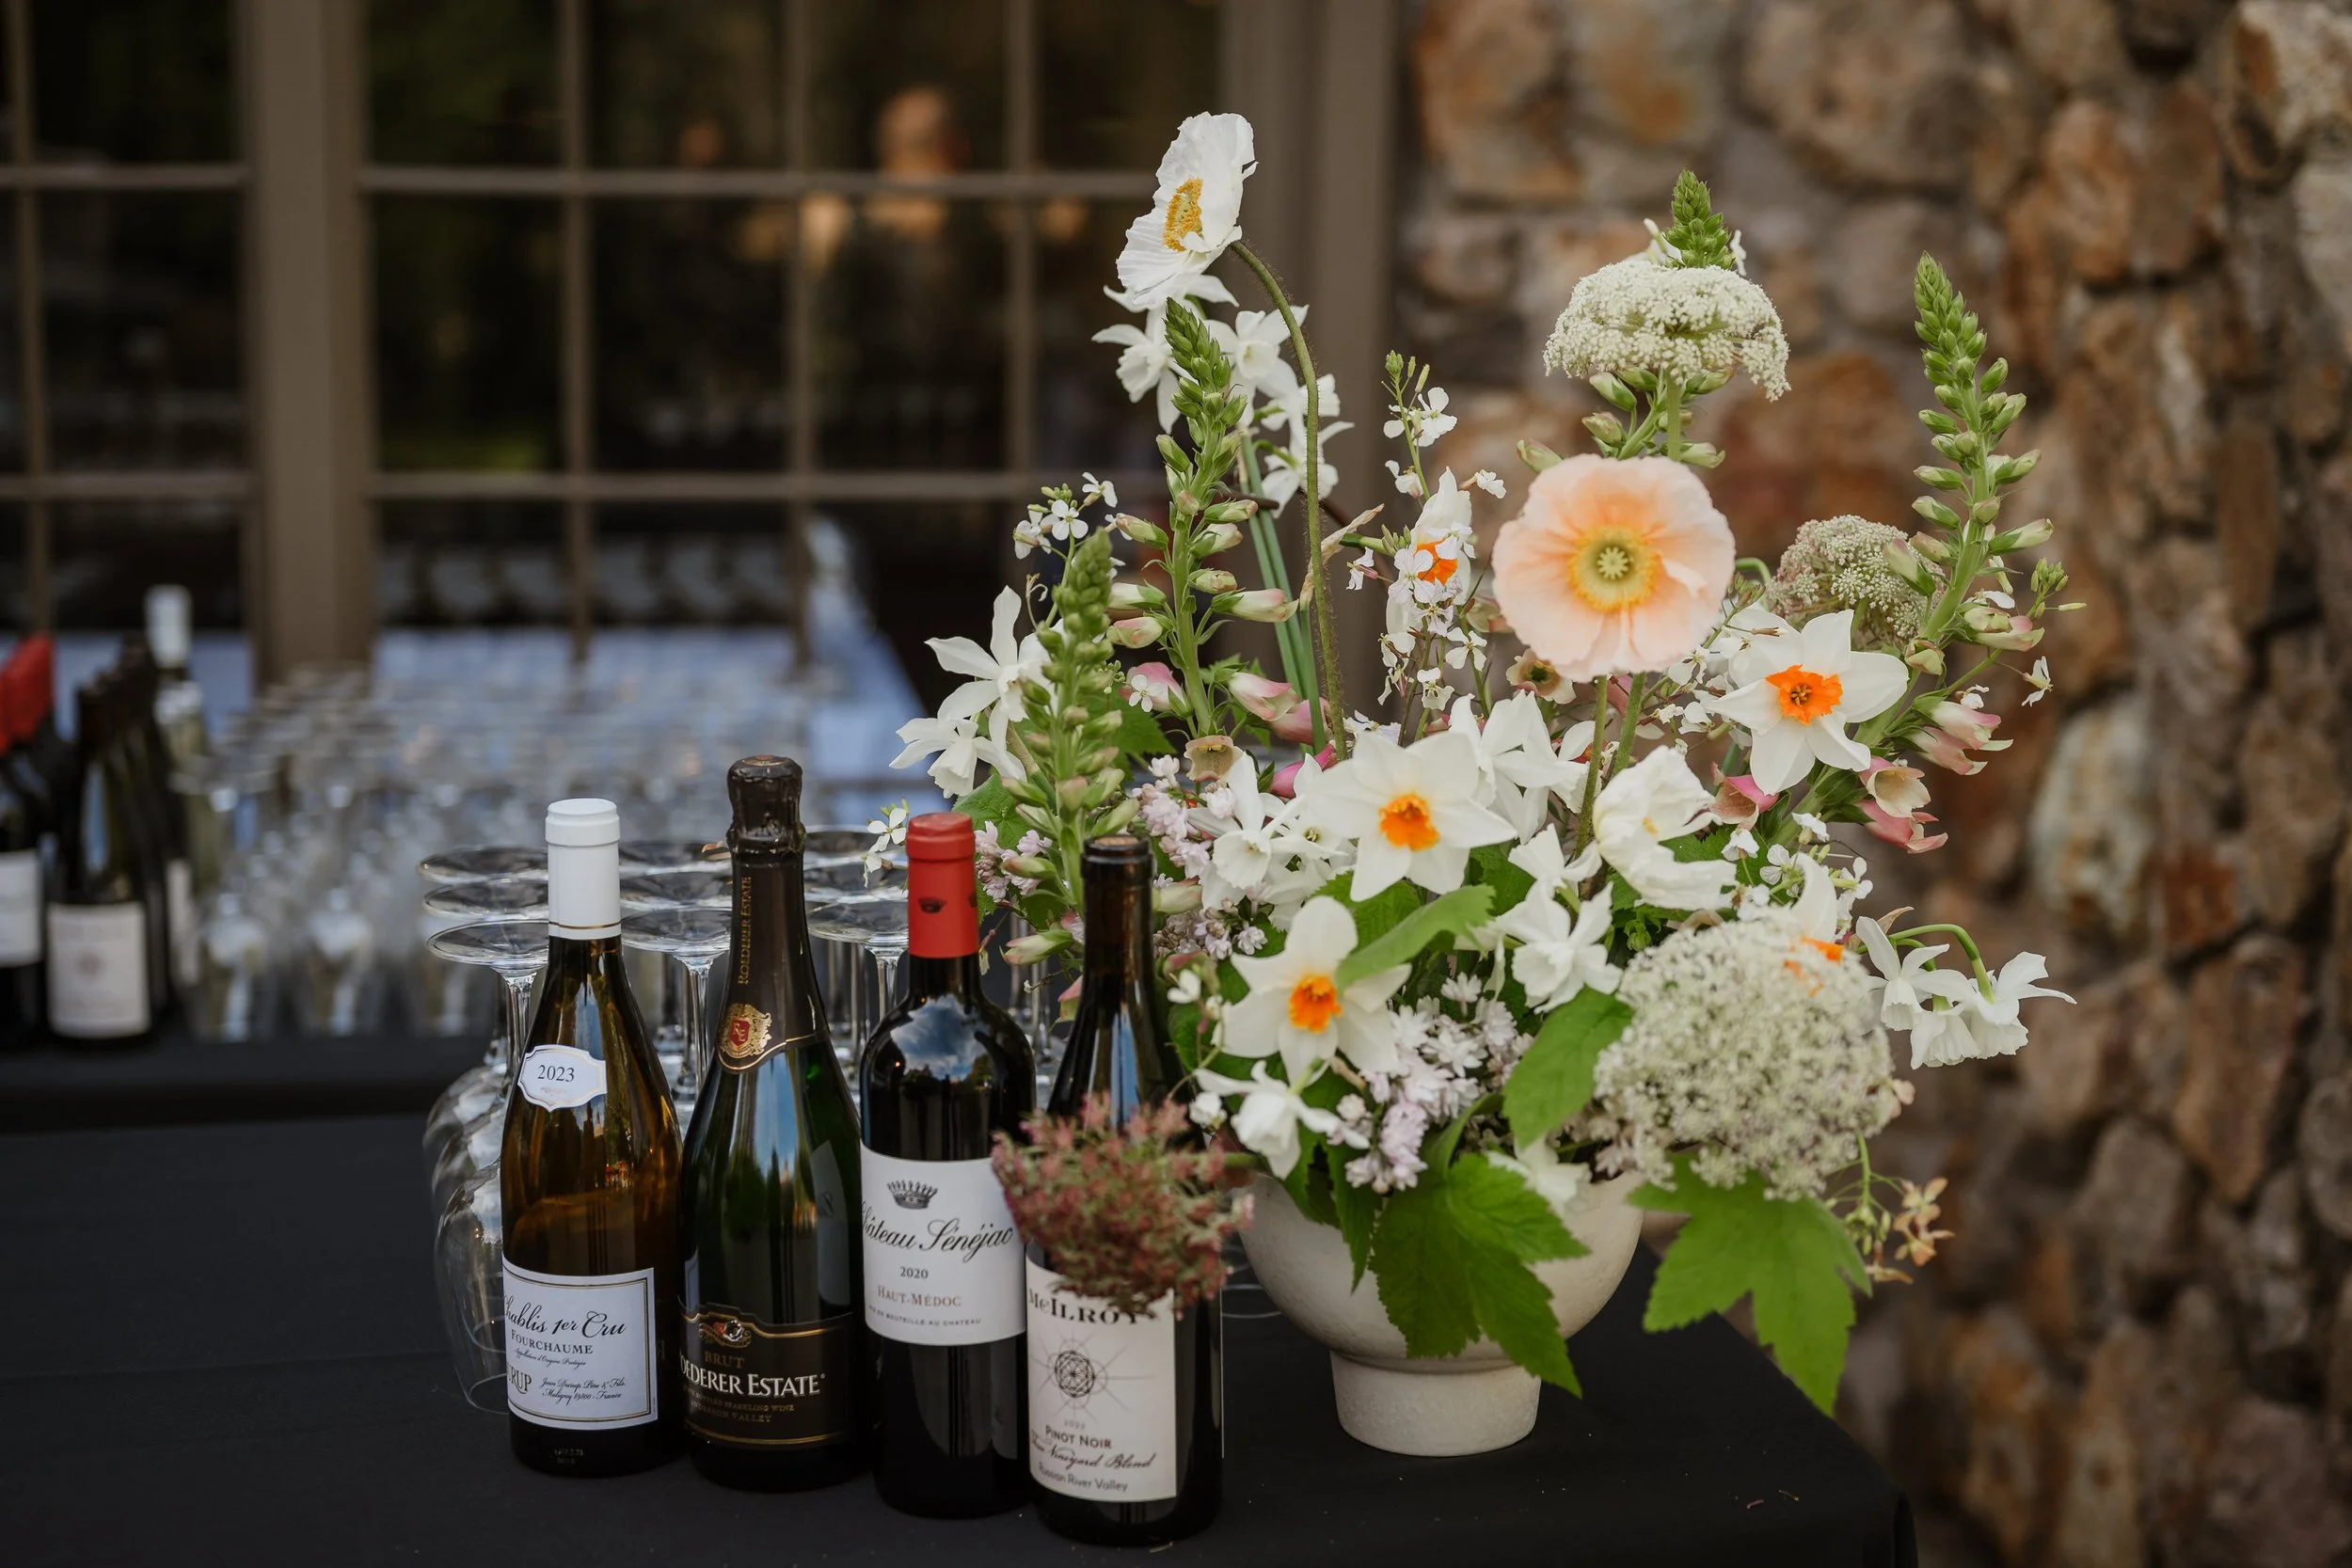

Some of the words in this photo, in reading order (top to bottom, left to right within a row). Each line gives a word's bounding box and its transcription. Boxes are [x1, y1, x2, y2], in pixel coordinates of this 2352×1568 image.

[740, 876, 752, 917] ESTATE
[738, 919, 751, 985] ROEDERER
[537, 1065, 575, 1083] 2023
[918, 1217, 1014, 1264] Sénéjac
[900, 1266, 929, 1280] 2020
[877, 1285, 961, 1307] HAUT-MÉDOC
[505, 1294, 548, 1333] hablis
[550, 1319, 579, 1335] 1er
[581, 1310, 628, 1338] Cru
[885, 1312, 925, 1326] BOUTEILLE
[511, 1329, 594, 1354] FOURCHAUME
[704, 1350, 745, 1370] BRUT
[679, 1346, 745, 1396] OEDERER
[748, 1373, 820, 1399] ESTATE
[732, 1412, 771, 1423] VALLEY
[1045, 1424, 1074, 1445] PINOT
[1079, 1435, 1112, 1449] NOIR
[1105, 1452, 1157, 1469] Blend
[1067, 1473, 1091, 1489] River
[1094, 1479, 1128, 1493] Valley
